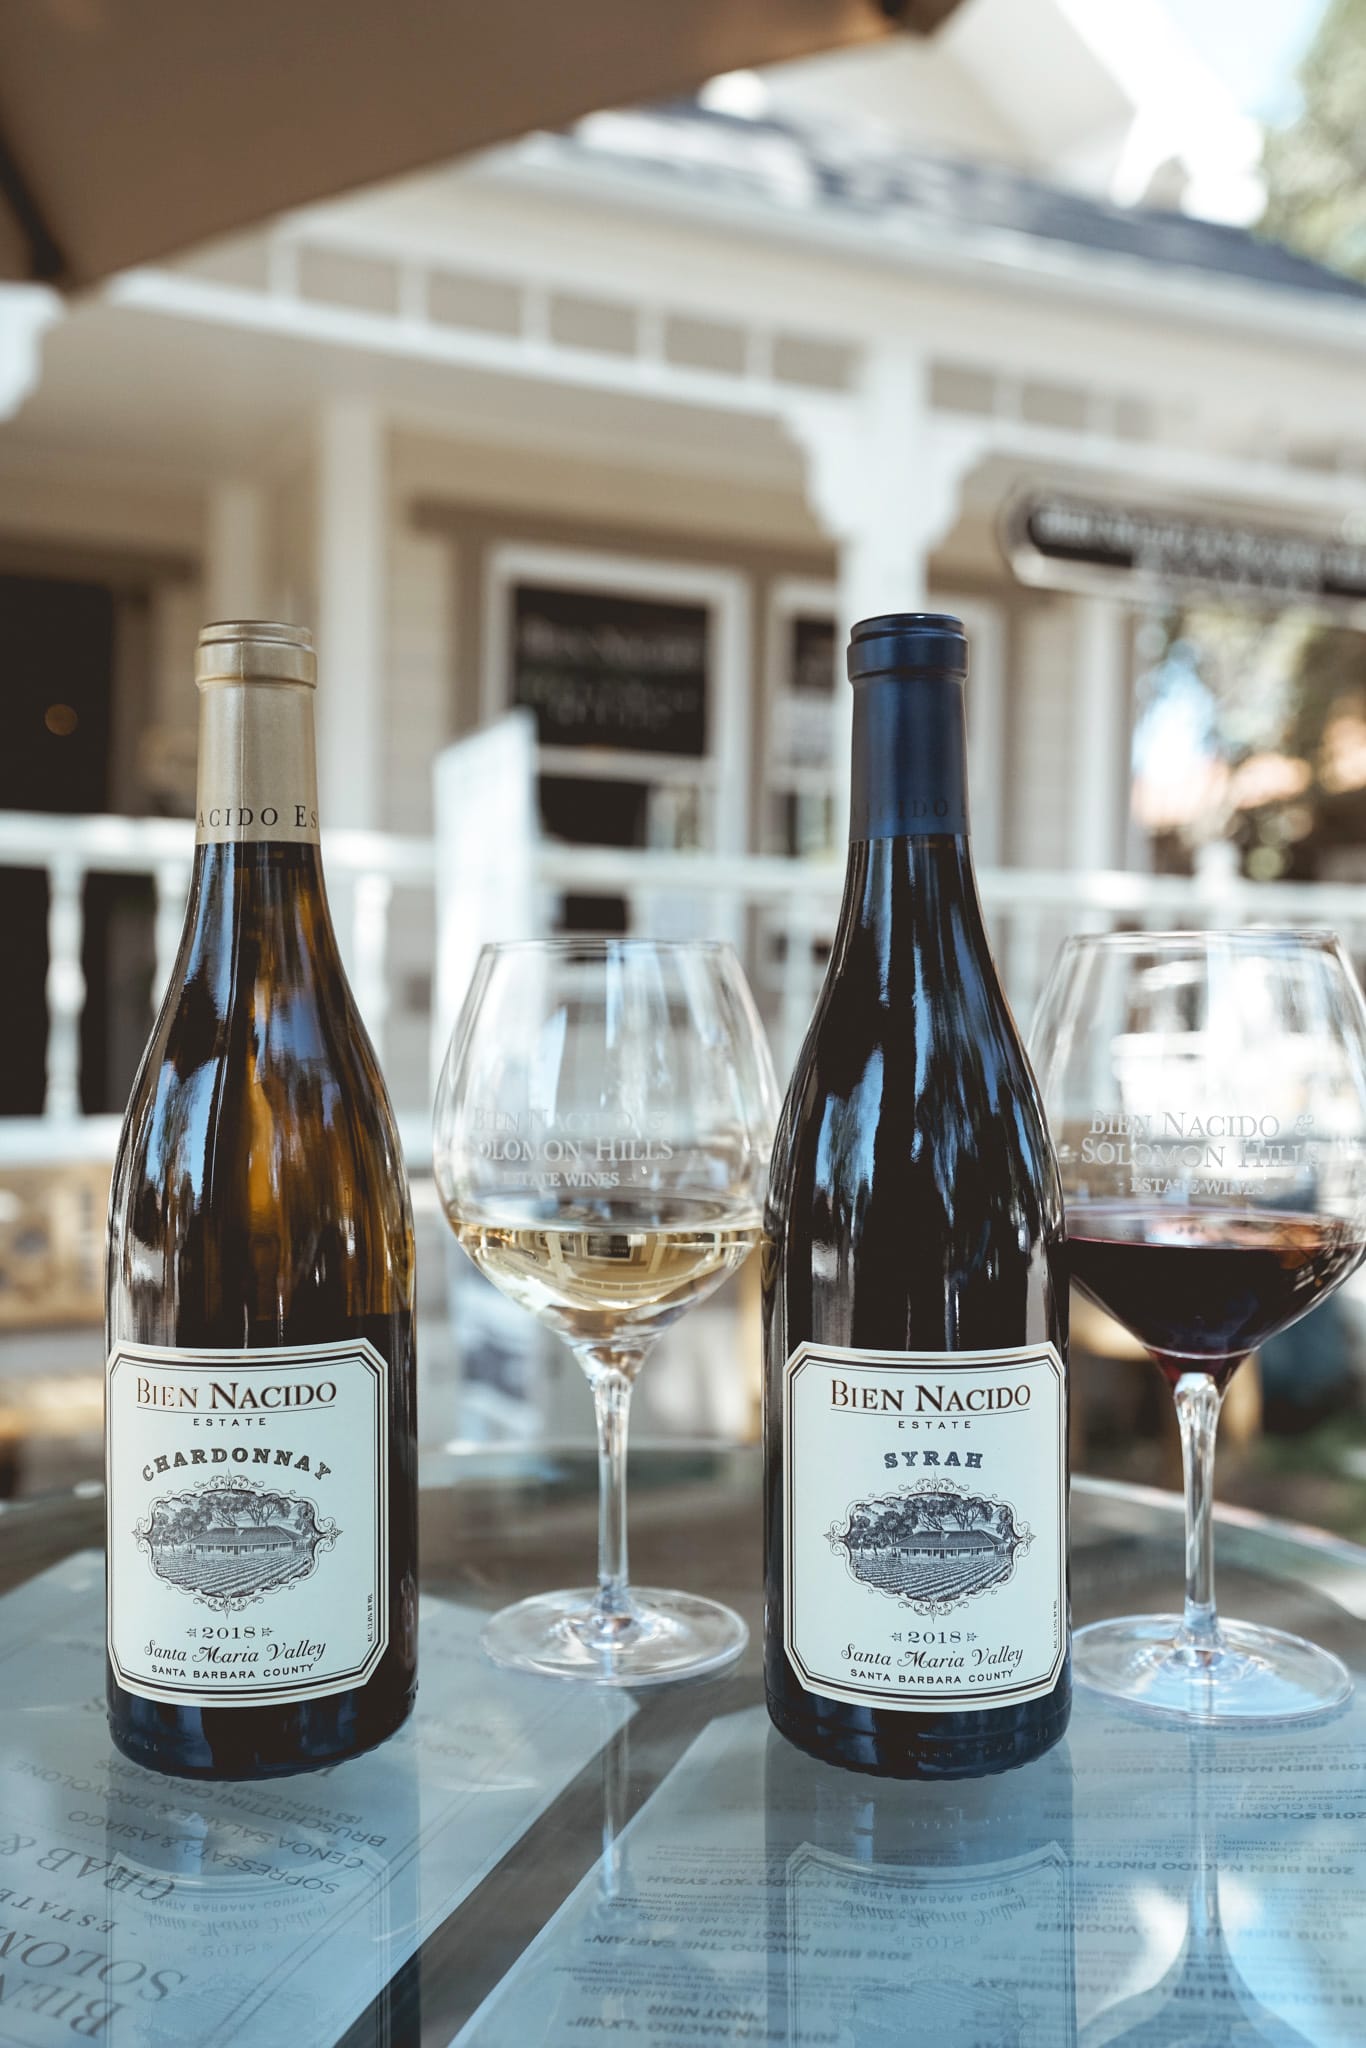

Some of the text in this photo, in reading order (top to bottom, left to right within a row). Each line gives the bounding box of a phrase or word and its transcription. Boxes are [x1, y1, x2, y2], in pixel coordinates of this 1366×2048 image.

[1089, 1111, 1151, 1136] BIEN
[1163, 1111, 1280, 1138] NACIDO
[595, 1136, 674, 1161] HILLS
[1081, 1138, 1225, 1168] SOLOMON
[564, 1172, 620, 1187] WINES
[136, 1377, 337, 1410] BIEN NACIDO
[831, 1379, 1031, 1412] BIEN NACIDO
[193, 1417, 266, 1426] ESTATE
[898, 1420, 971, 1429] ESTATE
[142, 1447, 331, 1482] CHARDONNAY
[884, 1450, 983, 1468] SYRAH
[201, 1626, 256, 1639] 2018
[907, 1631, 962, 1644] 2018
[144, 1640, 327, 1664] Santa Maria Valley
[841, 1644, 1024, 1668] Santa Maria Valley
[151, 1663, 314, 1679] SANTA BARBARA COUNTY
[850, 1669, 1013, 1684] SANTA BARBARA COUNTY
[214, 1794, 387, 1847] BRUSCHETTINI
[1215, 1812, 1317, 1821] SOLOMON
[68, 1810, 161, 1842] ASIAGO
[279, 1838, 364, 1869] GENOA
[183, 1843, 341, 1894] SOPRESSATA
[1094, 1861, 1157, 1871] PINOT
[1161, 1862, 1244, 1874] NACIDO
[646, 1875, 708, 1886] SYRAH
[699, 1928, 746, 1938] NOIR
